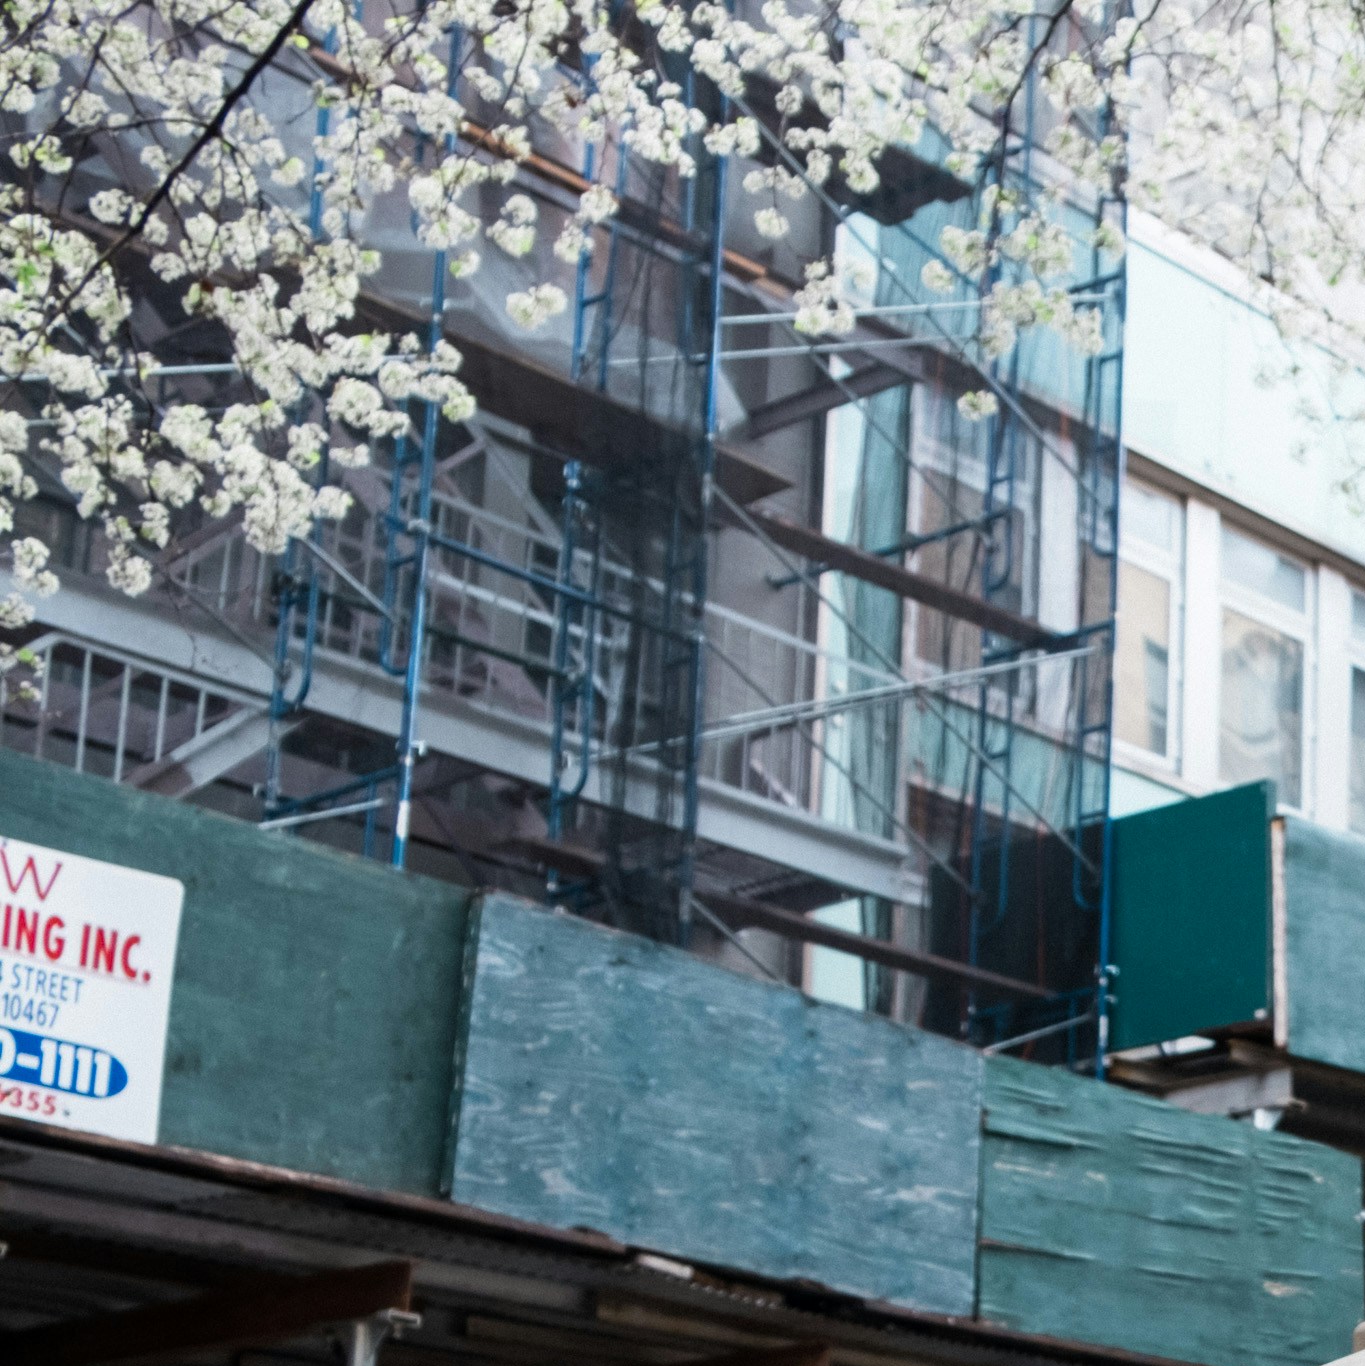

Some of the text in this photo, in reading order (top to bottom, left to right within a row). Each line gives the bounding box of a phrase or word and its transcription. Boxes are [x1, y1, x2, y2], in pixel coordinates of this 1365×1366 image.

[2, 904, 151, 983] ING INC.
[11, 963, 84, 1003] STREET
[3, 991, 59, 1029] 10467
